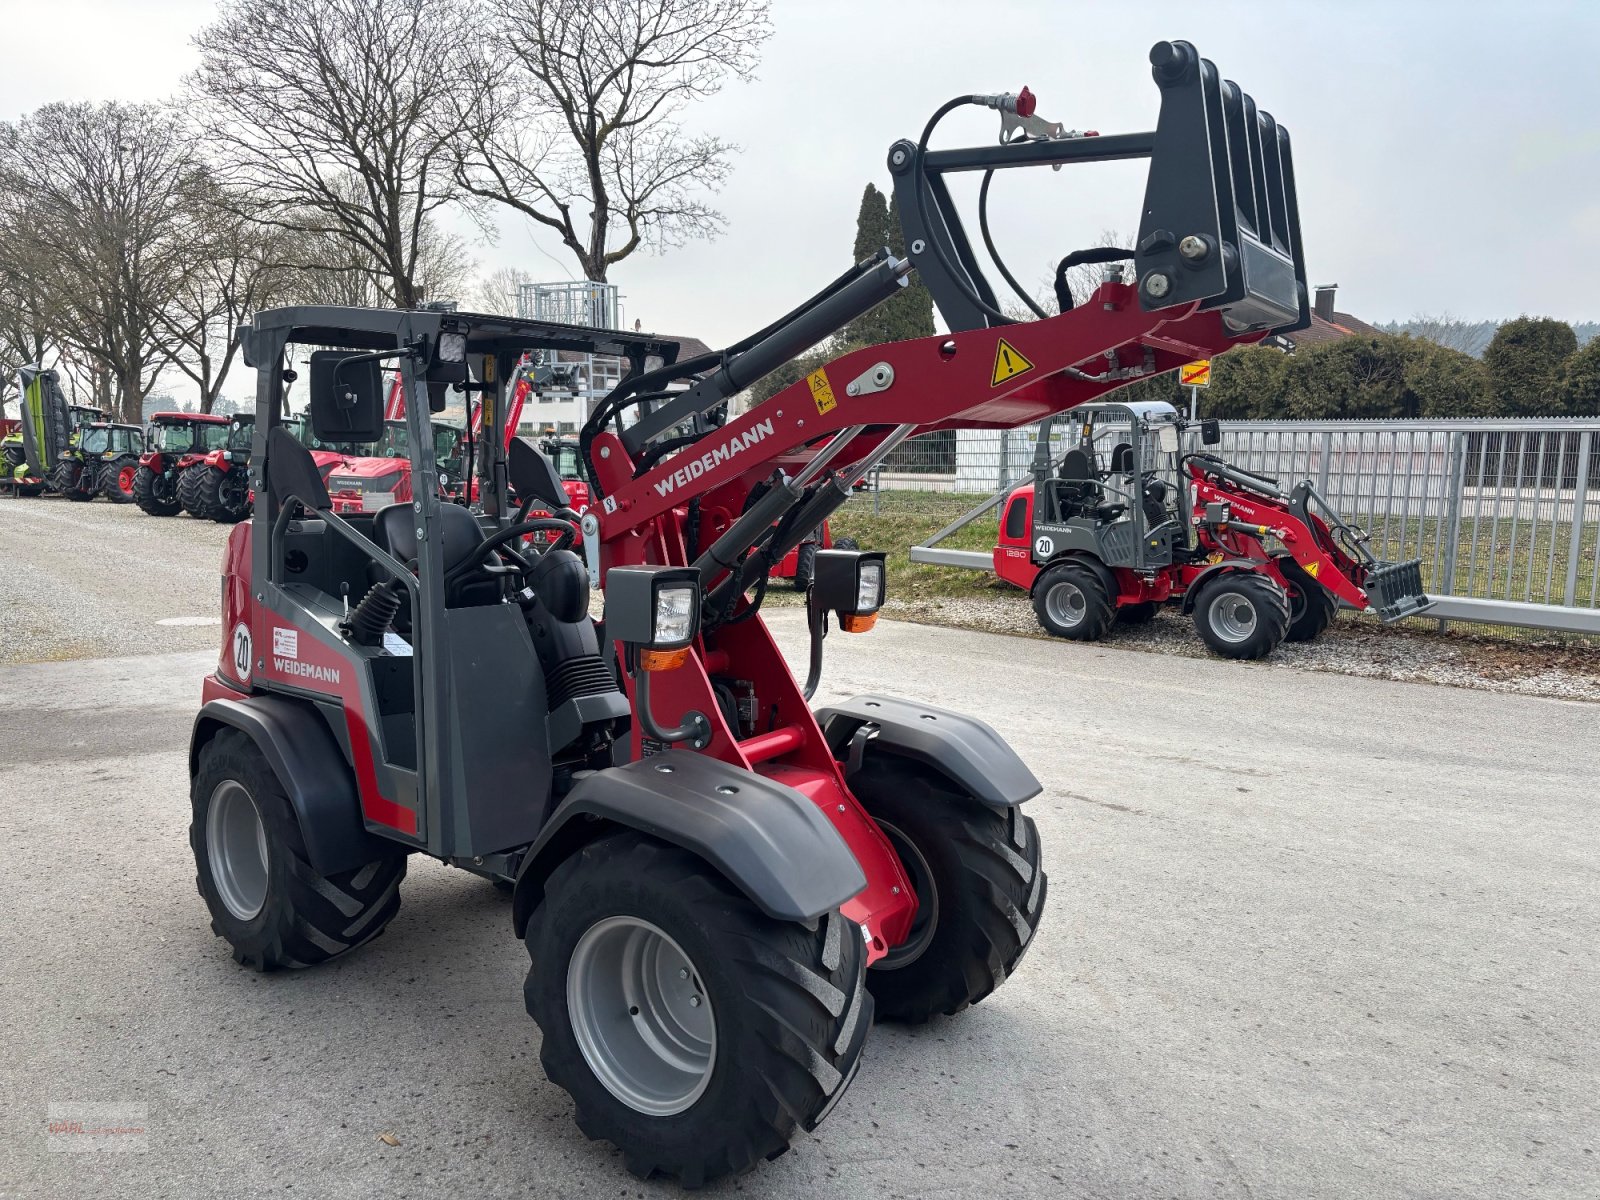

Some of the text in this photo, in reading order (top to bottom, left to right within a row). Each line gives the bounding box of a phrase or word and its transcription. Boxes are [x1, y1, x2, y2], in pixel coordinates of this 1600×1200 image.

[653, 417, 775, 498] WEIDEMANN
[1035, 525, 1072, 533] WEIDEMANN
[1039, 539, 1050, 553] 20
[237, 632, 249, 672] 20
[273, 657, 341, 684] WEIDEMANN
